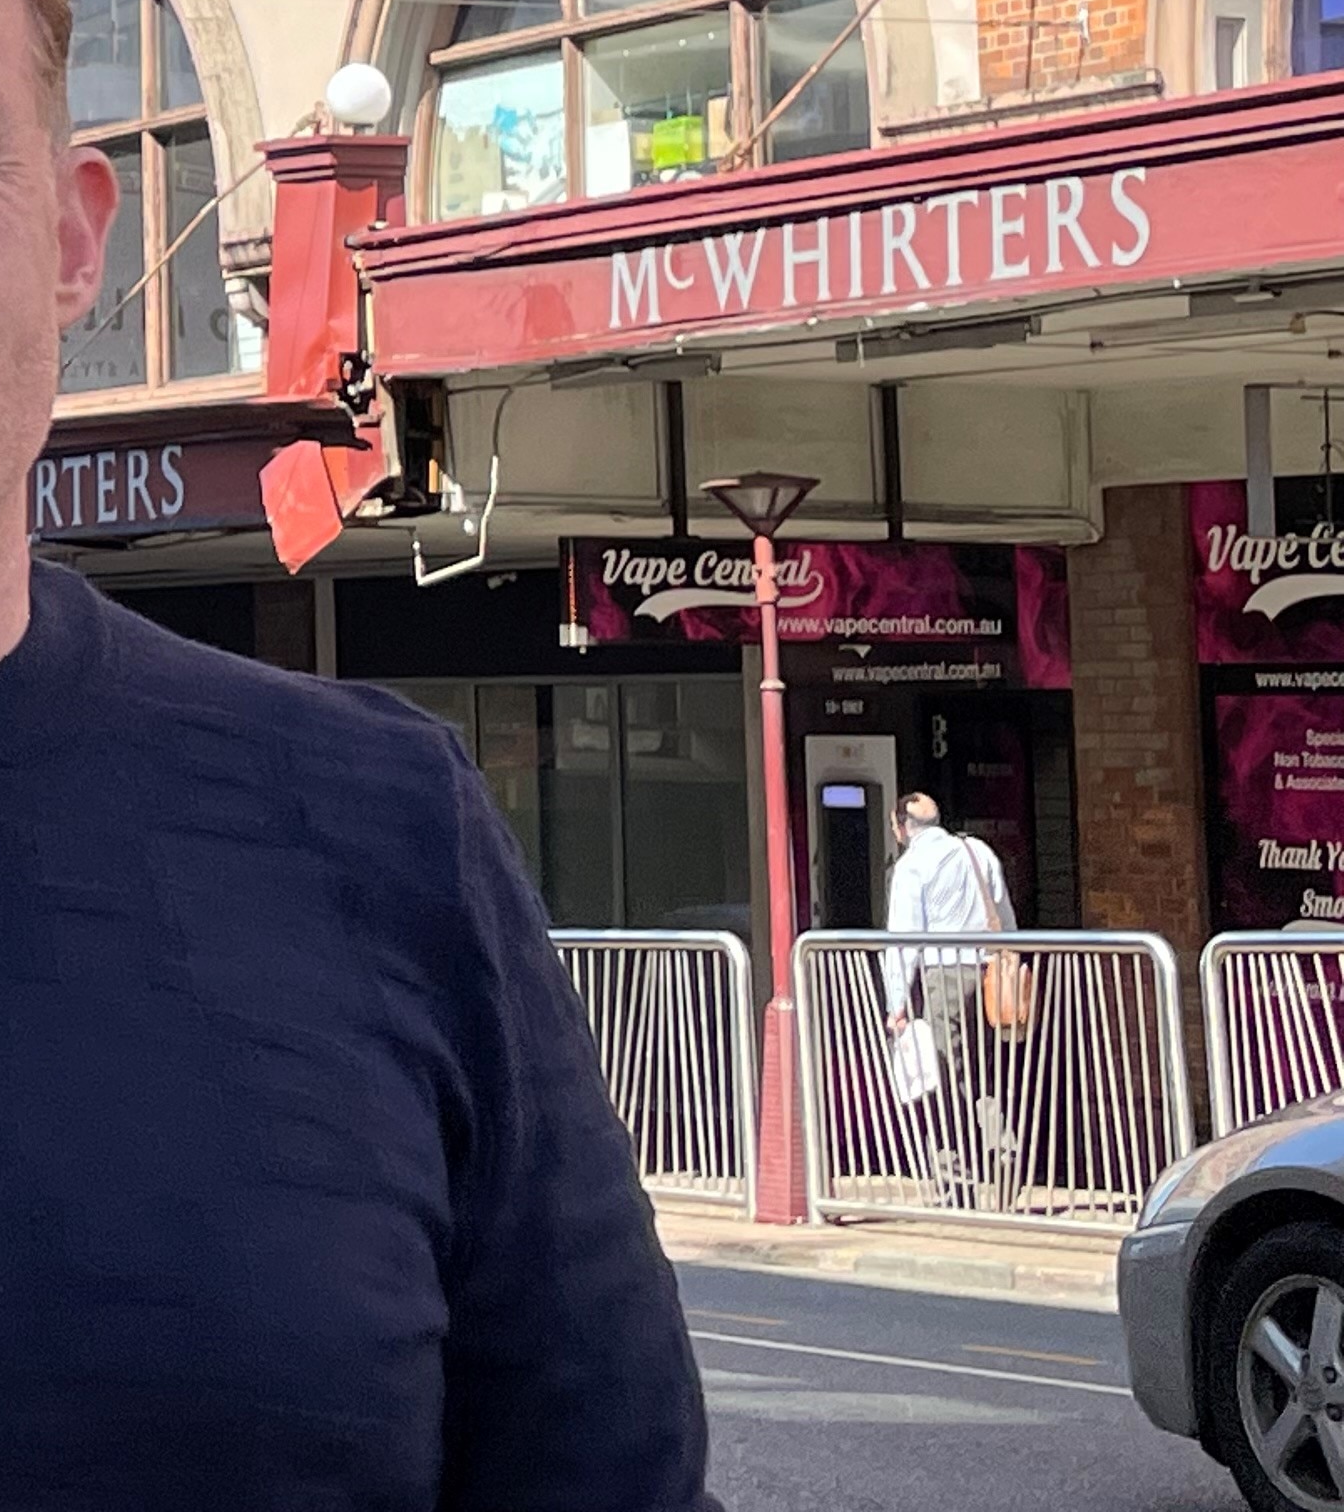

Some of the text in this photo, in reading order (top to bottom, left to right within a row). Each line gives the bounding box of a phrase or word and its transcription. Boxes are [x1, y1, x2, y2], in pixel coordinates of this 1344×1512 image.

[601, 548, 812, 596] Vape Cenal
[1207, 523, 1300, 586] Vape
[1258, 838, 1323, 871] Thank
